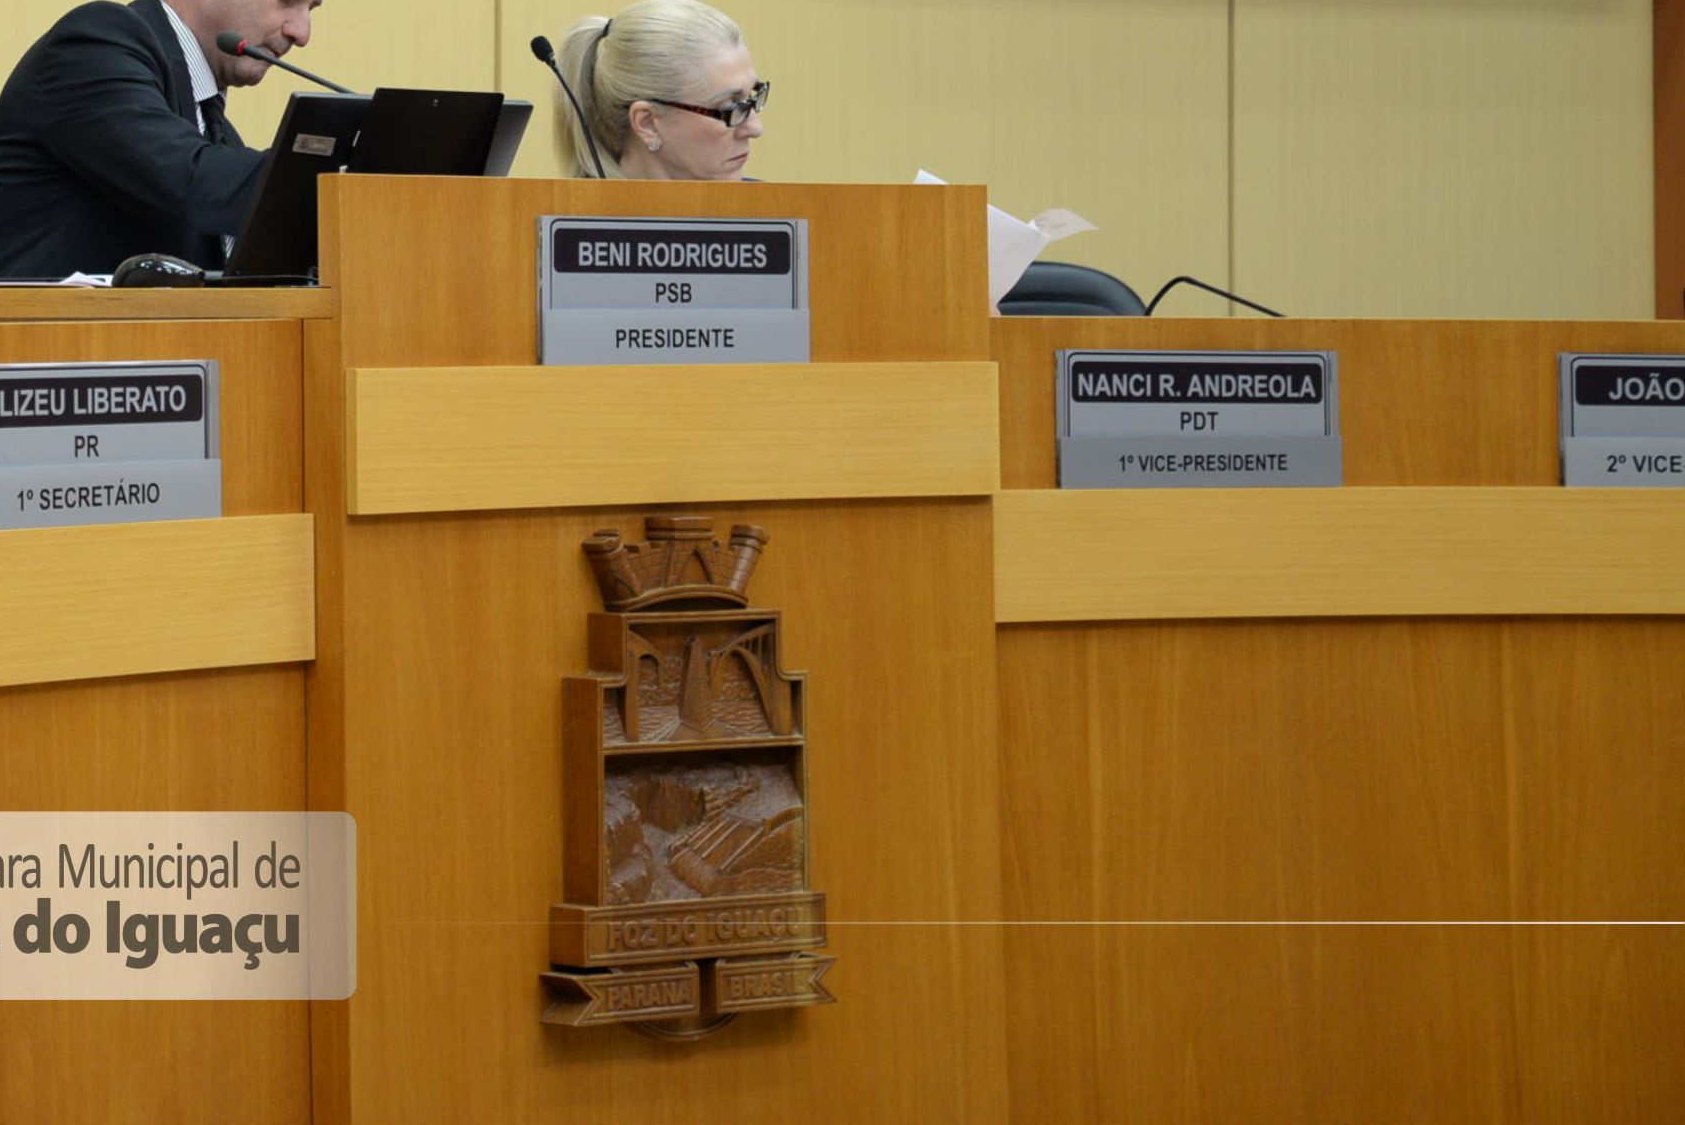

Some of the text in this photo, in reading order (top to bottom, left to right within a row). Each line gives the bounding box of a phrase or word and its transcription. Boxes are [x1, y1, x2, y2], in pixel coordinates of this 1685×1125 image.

[578, 242, 767, 268] BENI RODRIGUES
[655, 282, 692, 303] PSB
[615, 328, 735, 348] PRESIDENTE
[1077, 374, 1316, 398] NANCI R. ANDREOLA
[1608, 372, 1685, 401] JOÃO
[73, 385, 186, 415] LIBERATO
[1180, 411, 1219, 431] PDT
[74, 435, 99, 458] PR
[1119, 454, 1288, 473] 1º VICE-PRESIDENTE
[1606, 454, 1685, 473] 2º VICE
[16, 479, 160, 511] 1º SECRETÁRIO
[608, 920, 658, 950] FOZ
[664, 916, 698, 945] DO
[729, 971, 807, 997] BRASIL
